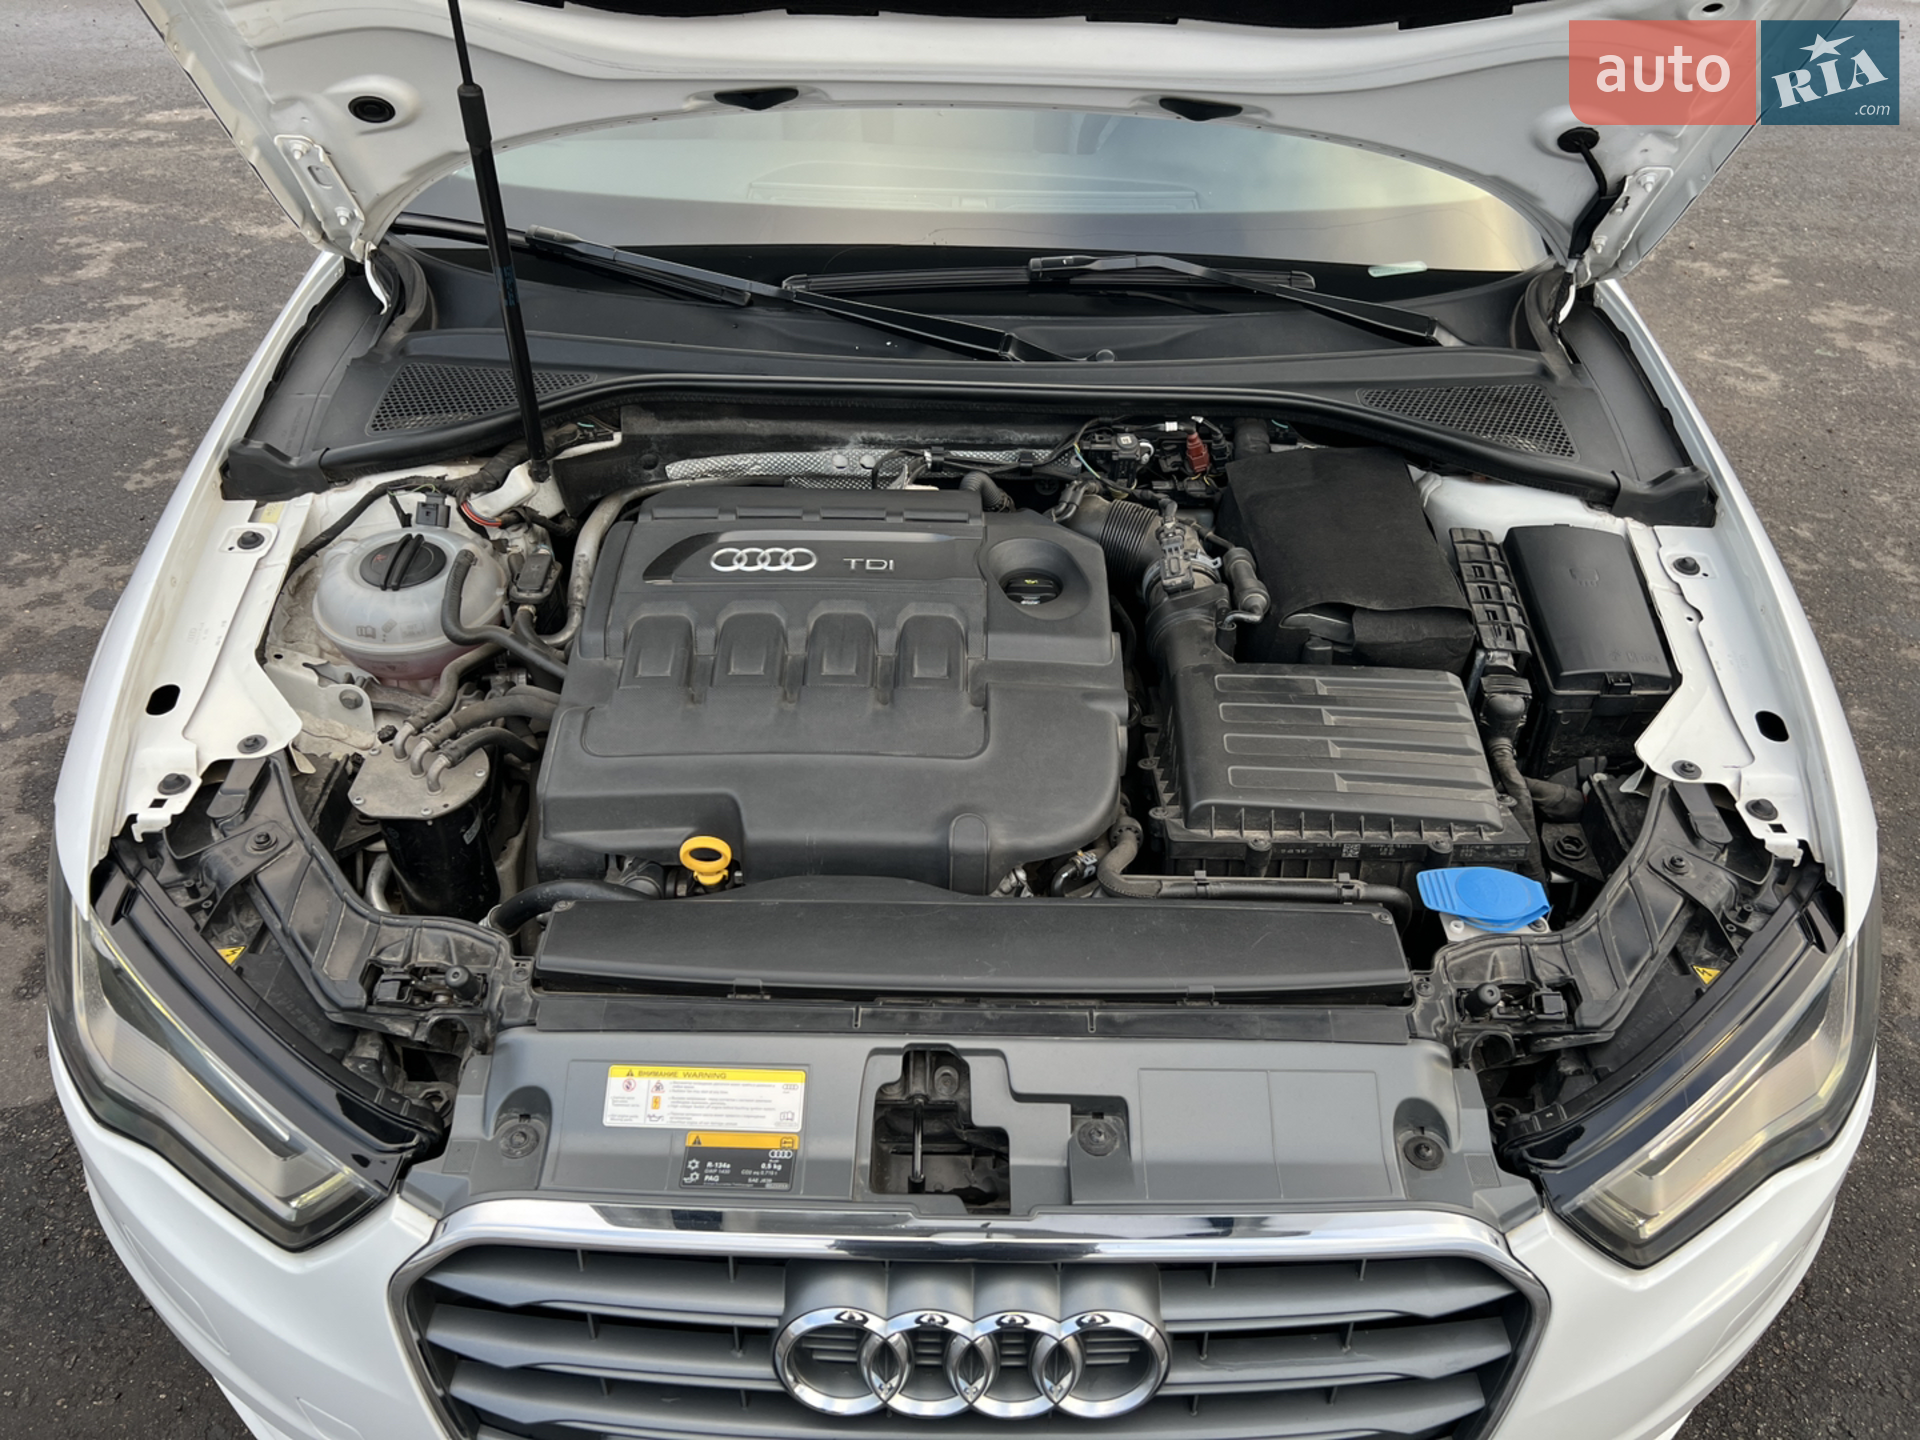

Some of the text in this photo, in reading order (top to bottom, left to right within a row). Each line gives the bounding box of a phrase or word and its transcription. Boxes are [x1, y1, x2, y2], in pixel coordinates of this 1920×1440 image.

[843, 557, 895, 571] TDI
[637, 1069, 727, 1080] ВНИМАНИЕ WARNING
[773, 1163, 782, 1171] kg
